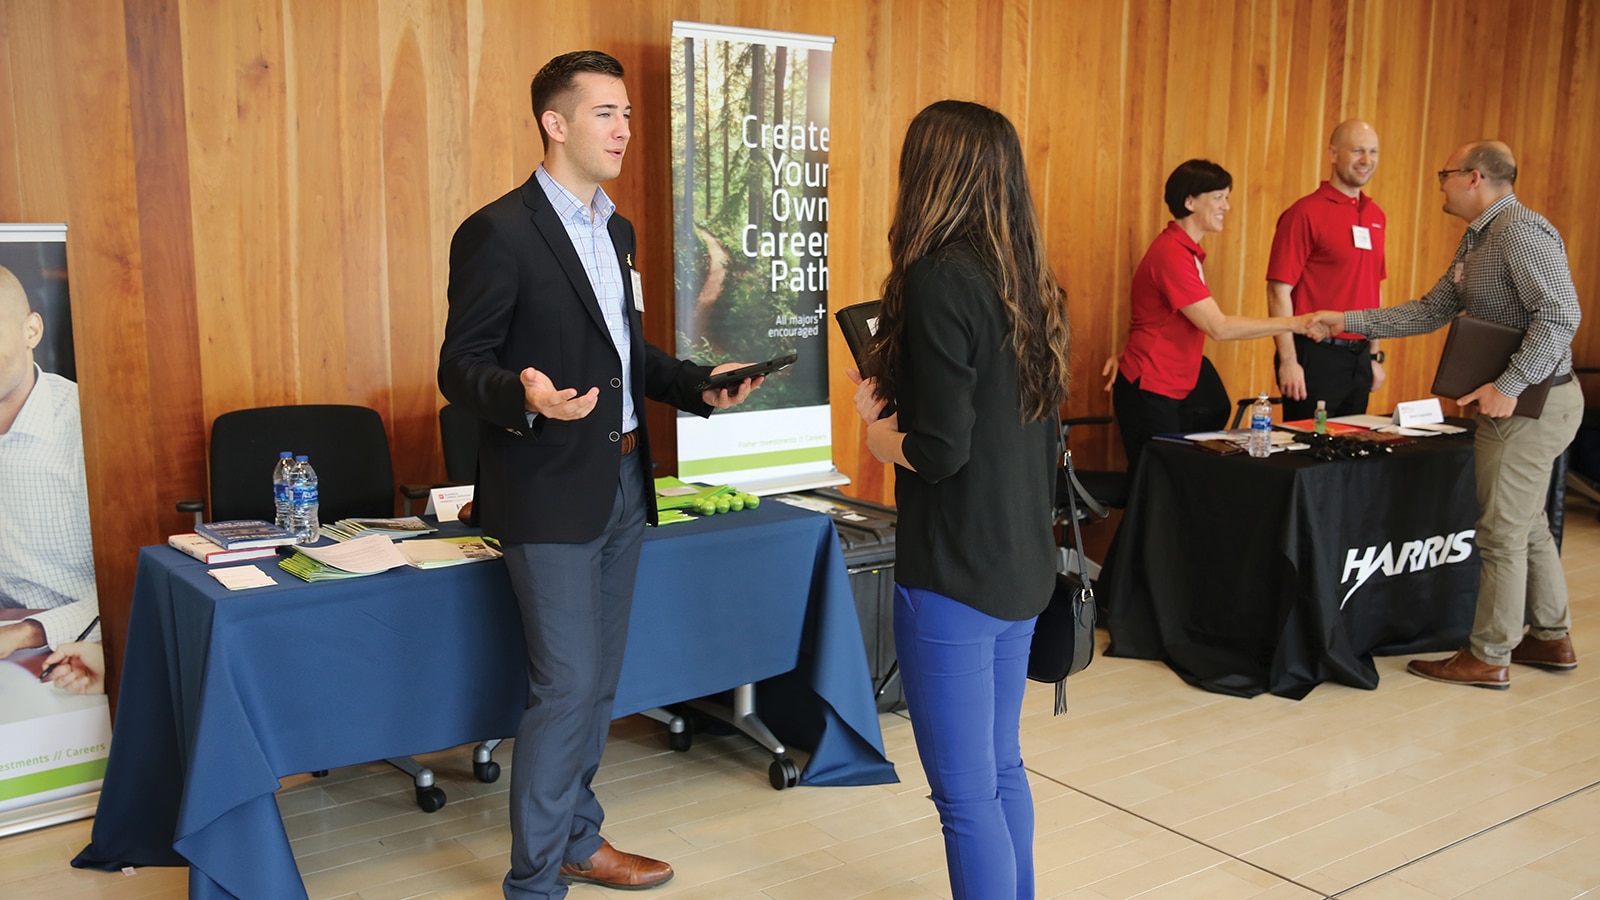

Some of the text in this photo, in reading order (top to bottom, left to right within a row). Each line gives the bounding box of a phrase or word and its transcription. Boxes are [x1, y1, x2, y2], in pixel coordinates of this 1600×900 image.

[742, 114, 830, 152] Create
[768, 153, 829, 187] Your
[772, 188, 829, 222] Own
[742, 224, 829, 257] Career
[771, 258, 829, 292] Path
[767, 325, 819, 338] encouraged
[775, 314, 819, 327] All majors
[1339, 529, 1477, 610] HARRIS
[65, 743, 106, 758] Careers
